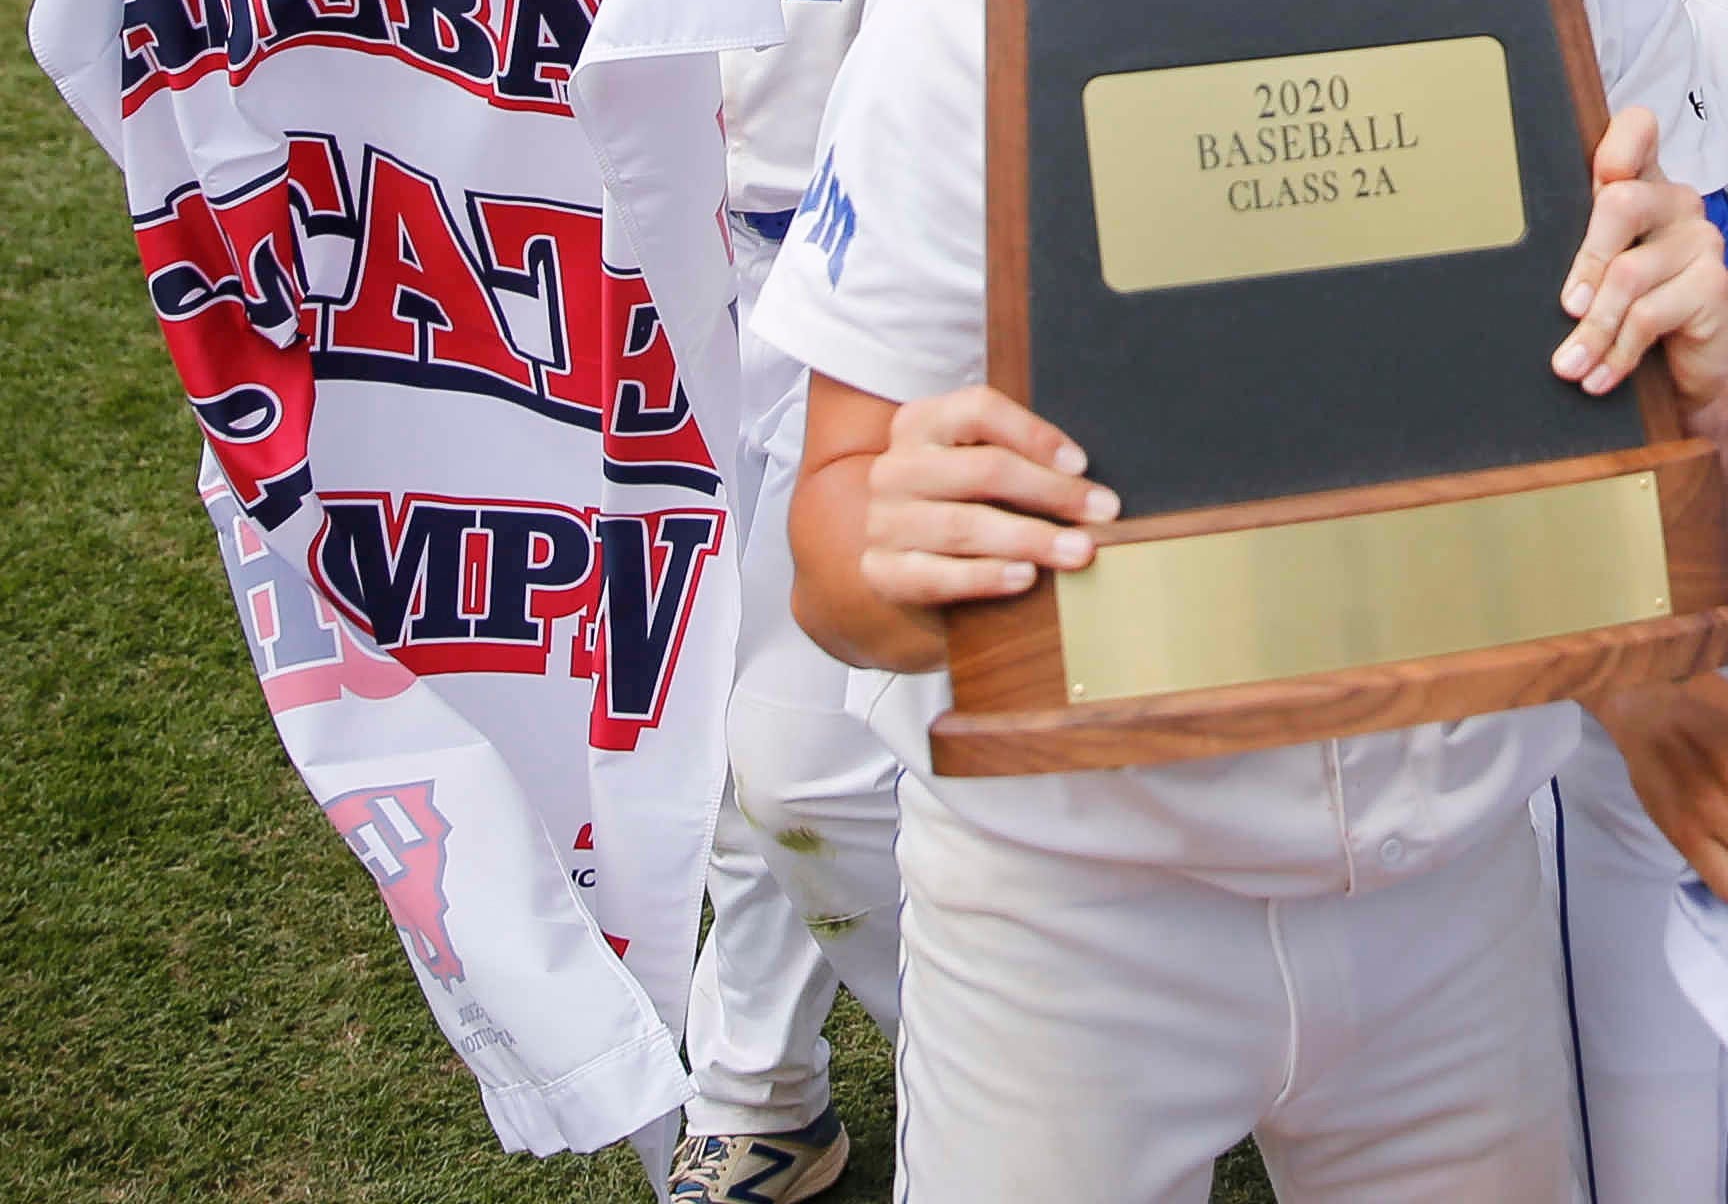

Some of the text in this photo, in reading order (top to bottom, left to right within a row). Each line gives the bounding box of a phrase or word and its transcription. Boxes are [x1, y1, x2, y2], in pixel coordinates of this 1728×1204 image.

[1255, 75, 1350, 118] 2020
[1195, 112, 1419, 172] BASEBALL
[1227, 165, 1399, 214] CLASS 2A
